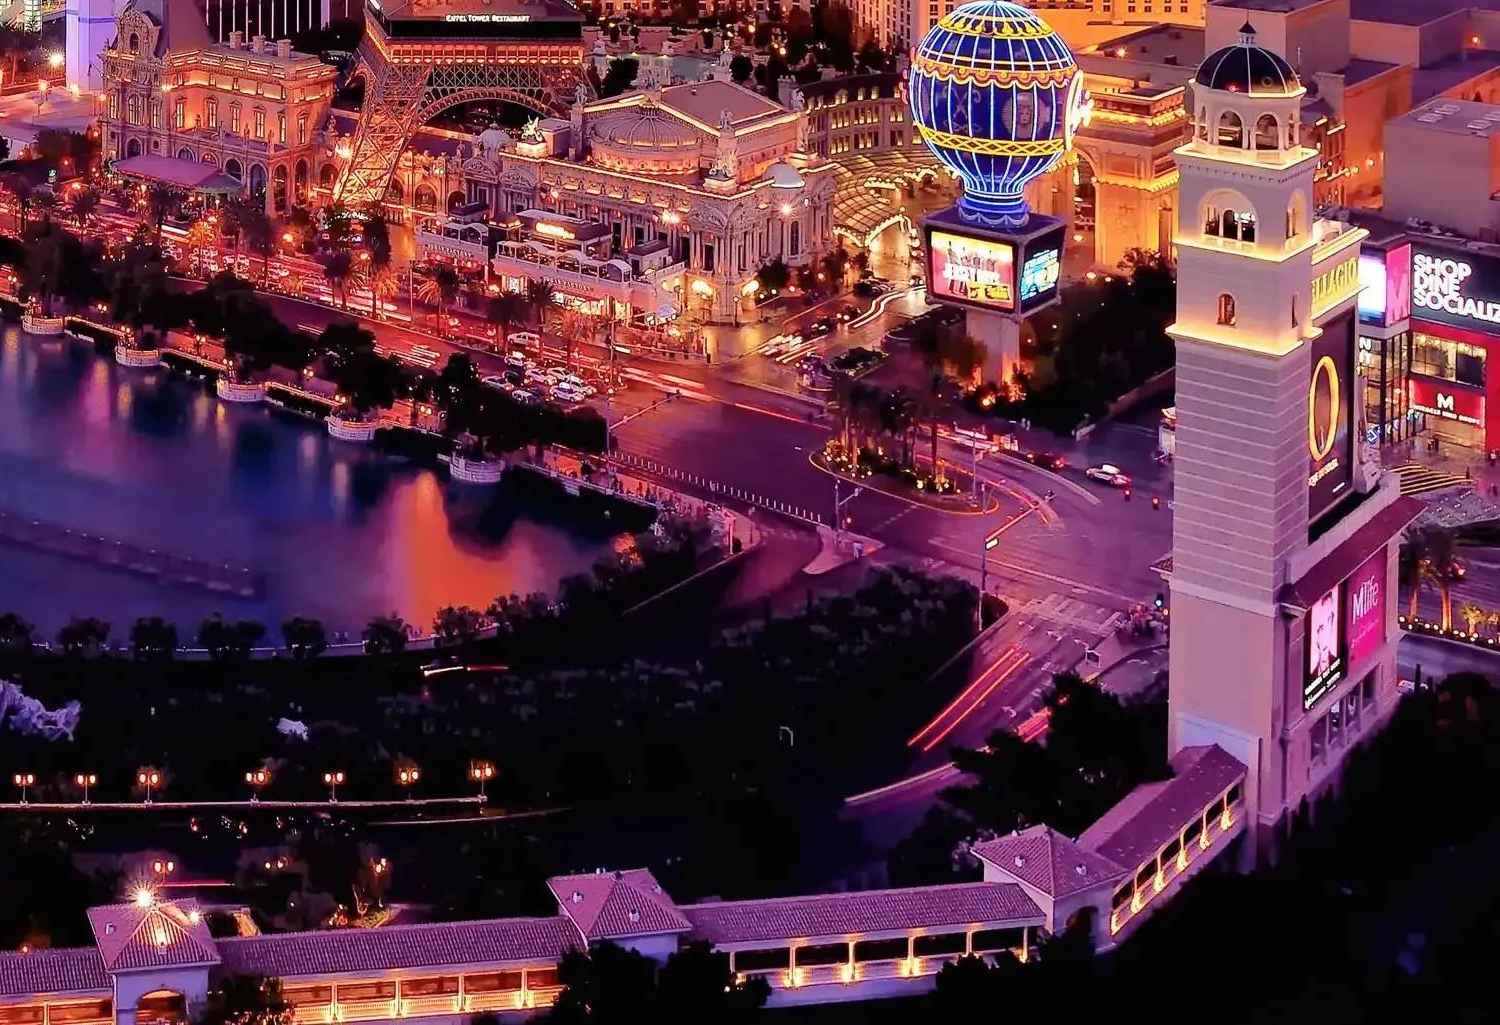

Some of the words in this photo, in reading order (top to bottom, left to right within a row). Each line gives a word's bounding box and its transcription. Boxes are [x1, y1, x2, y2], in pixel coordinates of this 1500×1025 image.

[467, 14, 490, 23] TOWER
[1413, 254, 1472, 279] SHOP
[1414, 273, 1461, 296] DINE
[1437, 392, 1454, 411] M
